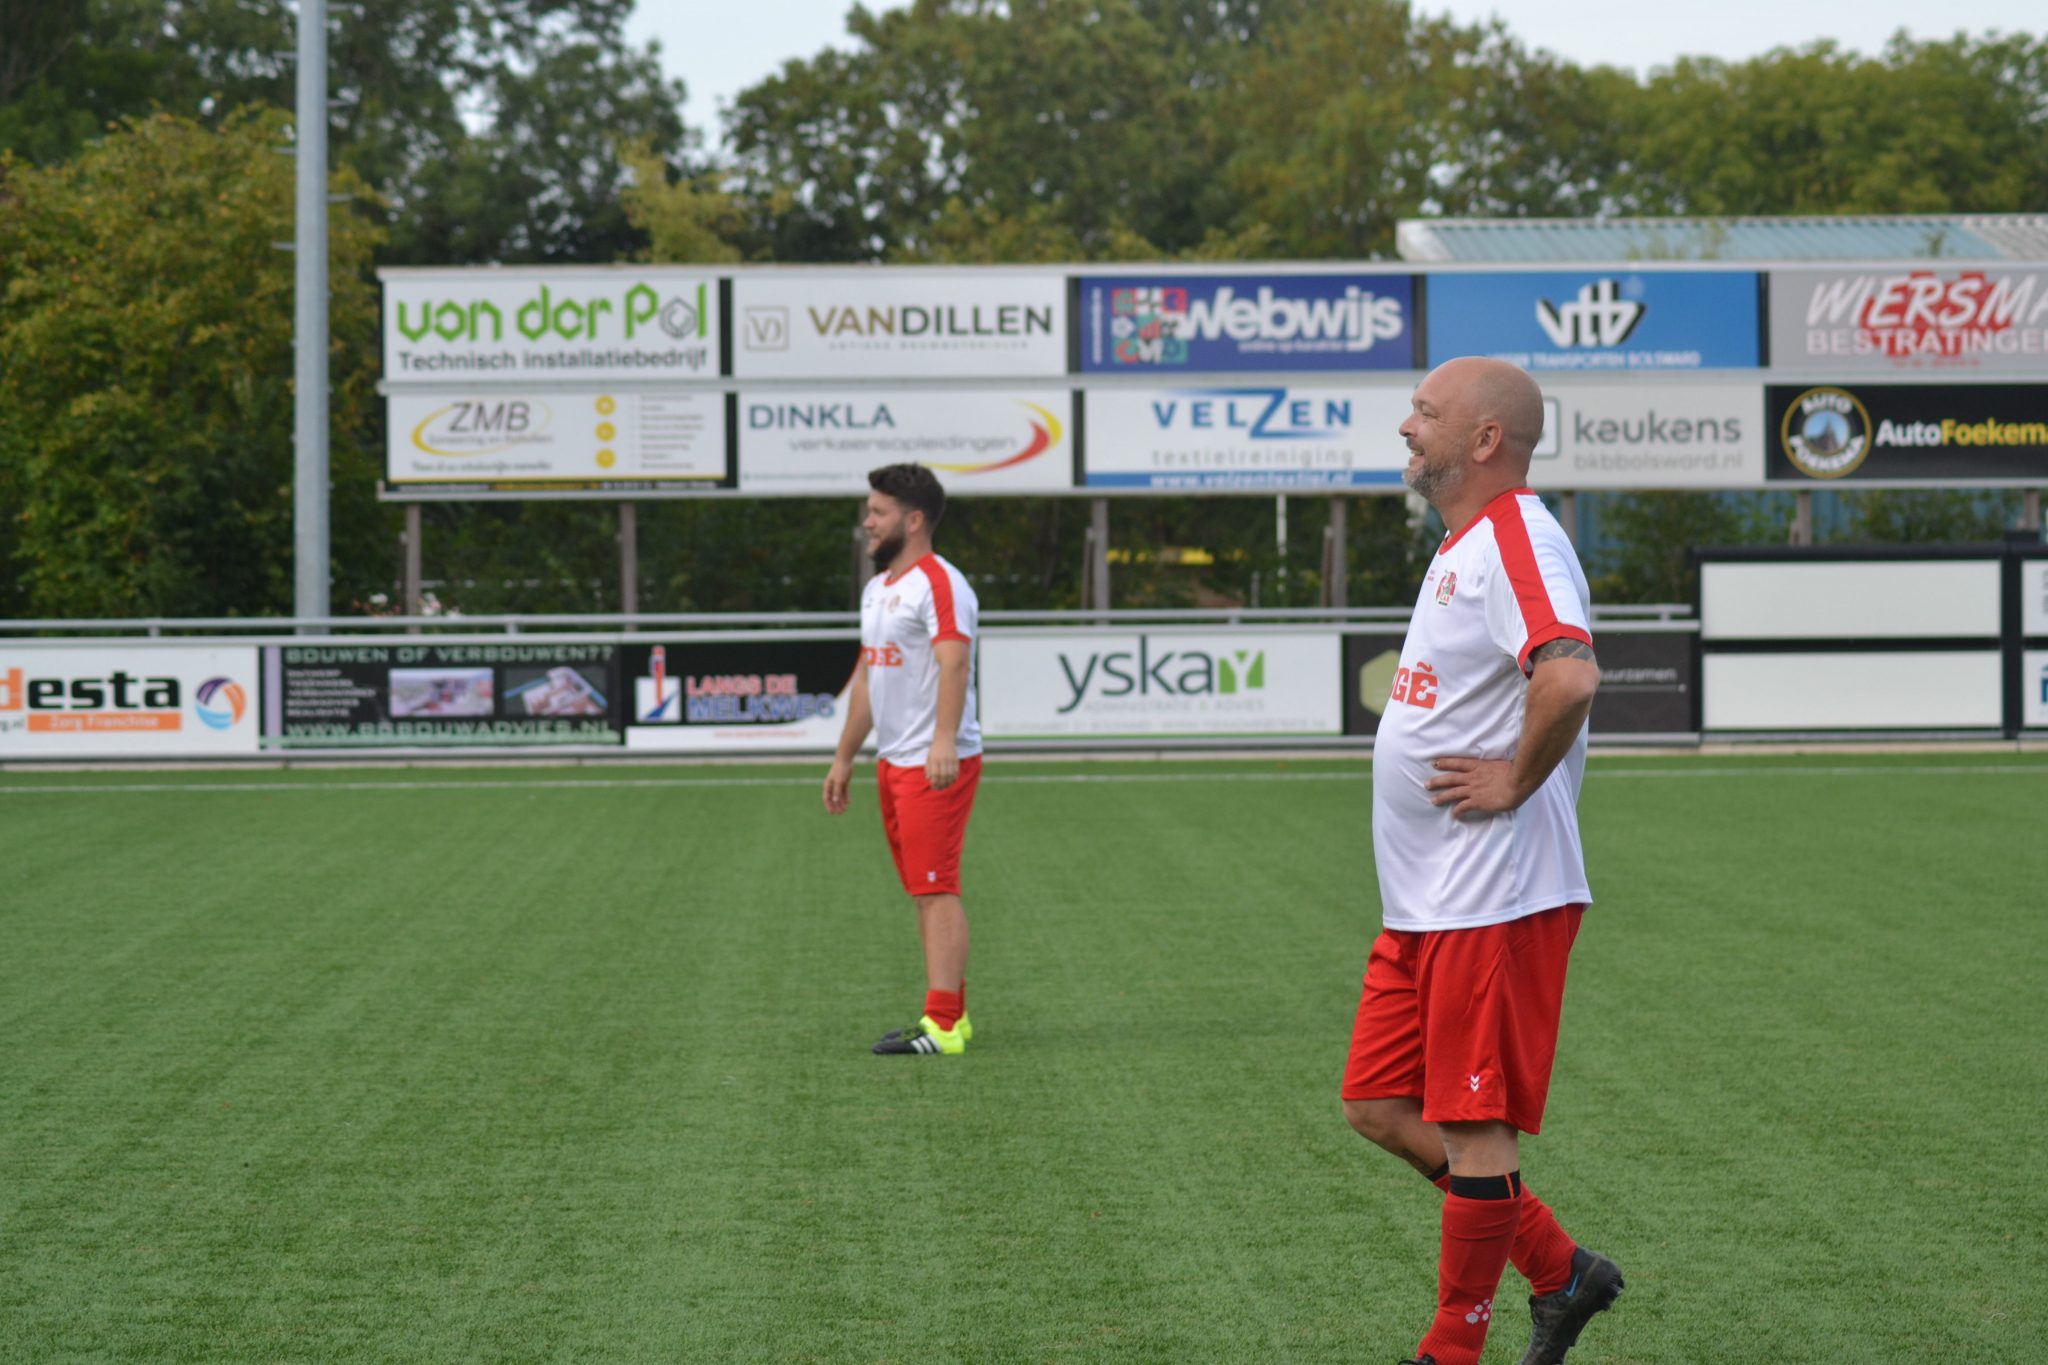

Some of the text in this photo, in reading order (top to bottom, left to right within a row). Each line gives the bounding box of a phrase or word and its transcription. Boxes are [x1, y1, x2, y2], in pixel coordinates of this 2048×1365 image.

[1180, 286, 1403, 351] Webwijs
[1806, 328, 2048, 355] BESTRATINGE
[399, 349, 708, 372] Technisch installatiebedrijf
[449, 402, 531, 431] ZMB
[749, 404, 896, 429] DINKLA
[1152, 387, 1352, 439] VELZEN
[1574, 411, 1742, 444] keukens
[1875, 417, 2048, 446] AutoFoekem
[789, 434, 1018, 455] verkeersopleidingen
[1152, 448, 1355, 467] textielreiniging
[286, 647, 389, 664] BOUWEN
[398, 647, 427, 662] OF
[687, 673, 798, 695] LANGS DE
[687, 693, 836, 722] MELKWEG
